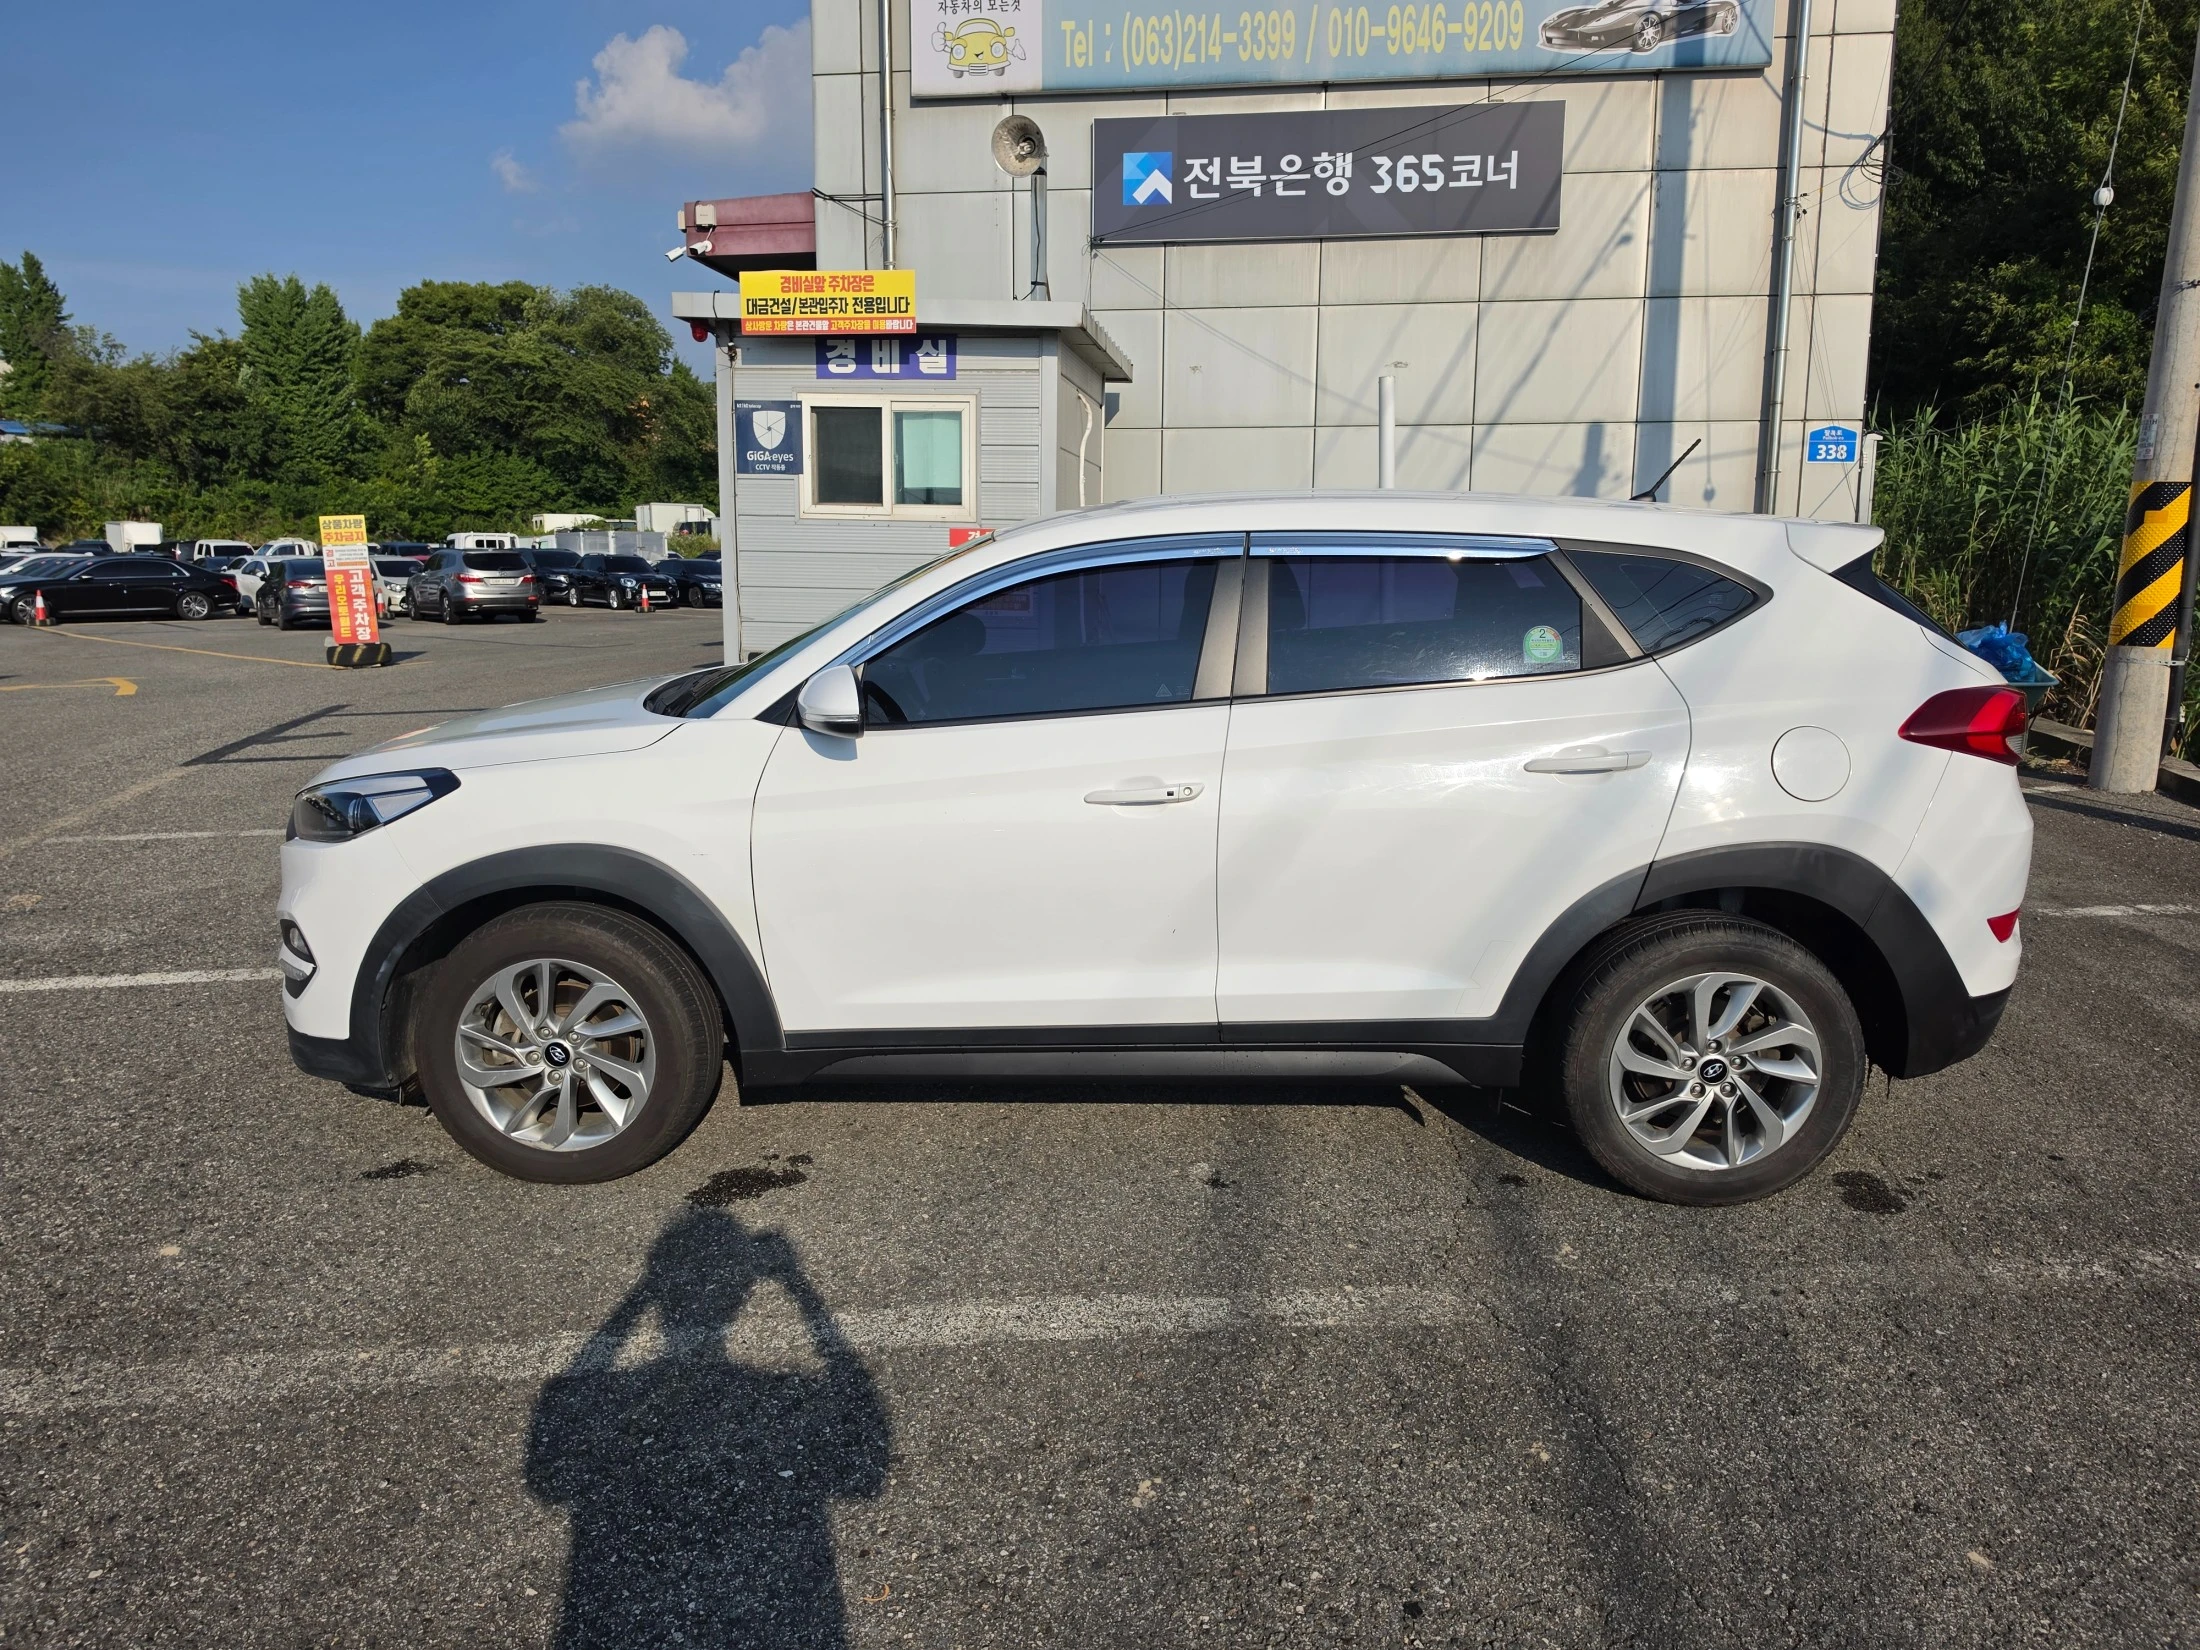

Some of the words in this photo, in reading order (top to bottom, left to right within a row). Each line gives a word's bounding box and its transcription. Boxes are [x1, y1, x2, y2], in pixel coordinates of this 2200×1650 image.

[937, 0, 983, 15] 자동차의
[1061, 20, 1093, 68] Tel
[1122, 9, 1296, 73] (063)214-3399
[1328, 0, 1524, 58] 010-9646-9209
[1183, 151, 1352, 199] 전북은행
[1370, 150, 1518, 194] 365코너
[780, 275, 826, 293] 경비실앞
[828, 274, 875, 293] 주차장은
[852, 296, 910, 315] 전용입니다
[1816, 444, 1847, 460] 338
[321, 518, 363, 529] 상품차량
[323, 531, 365, 542] 주차금지
[349, 569, 371, 640] 고객주차장
[1539, 628, 1546, 639] 2
